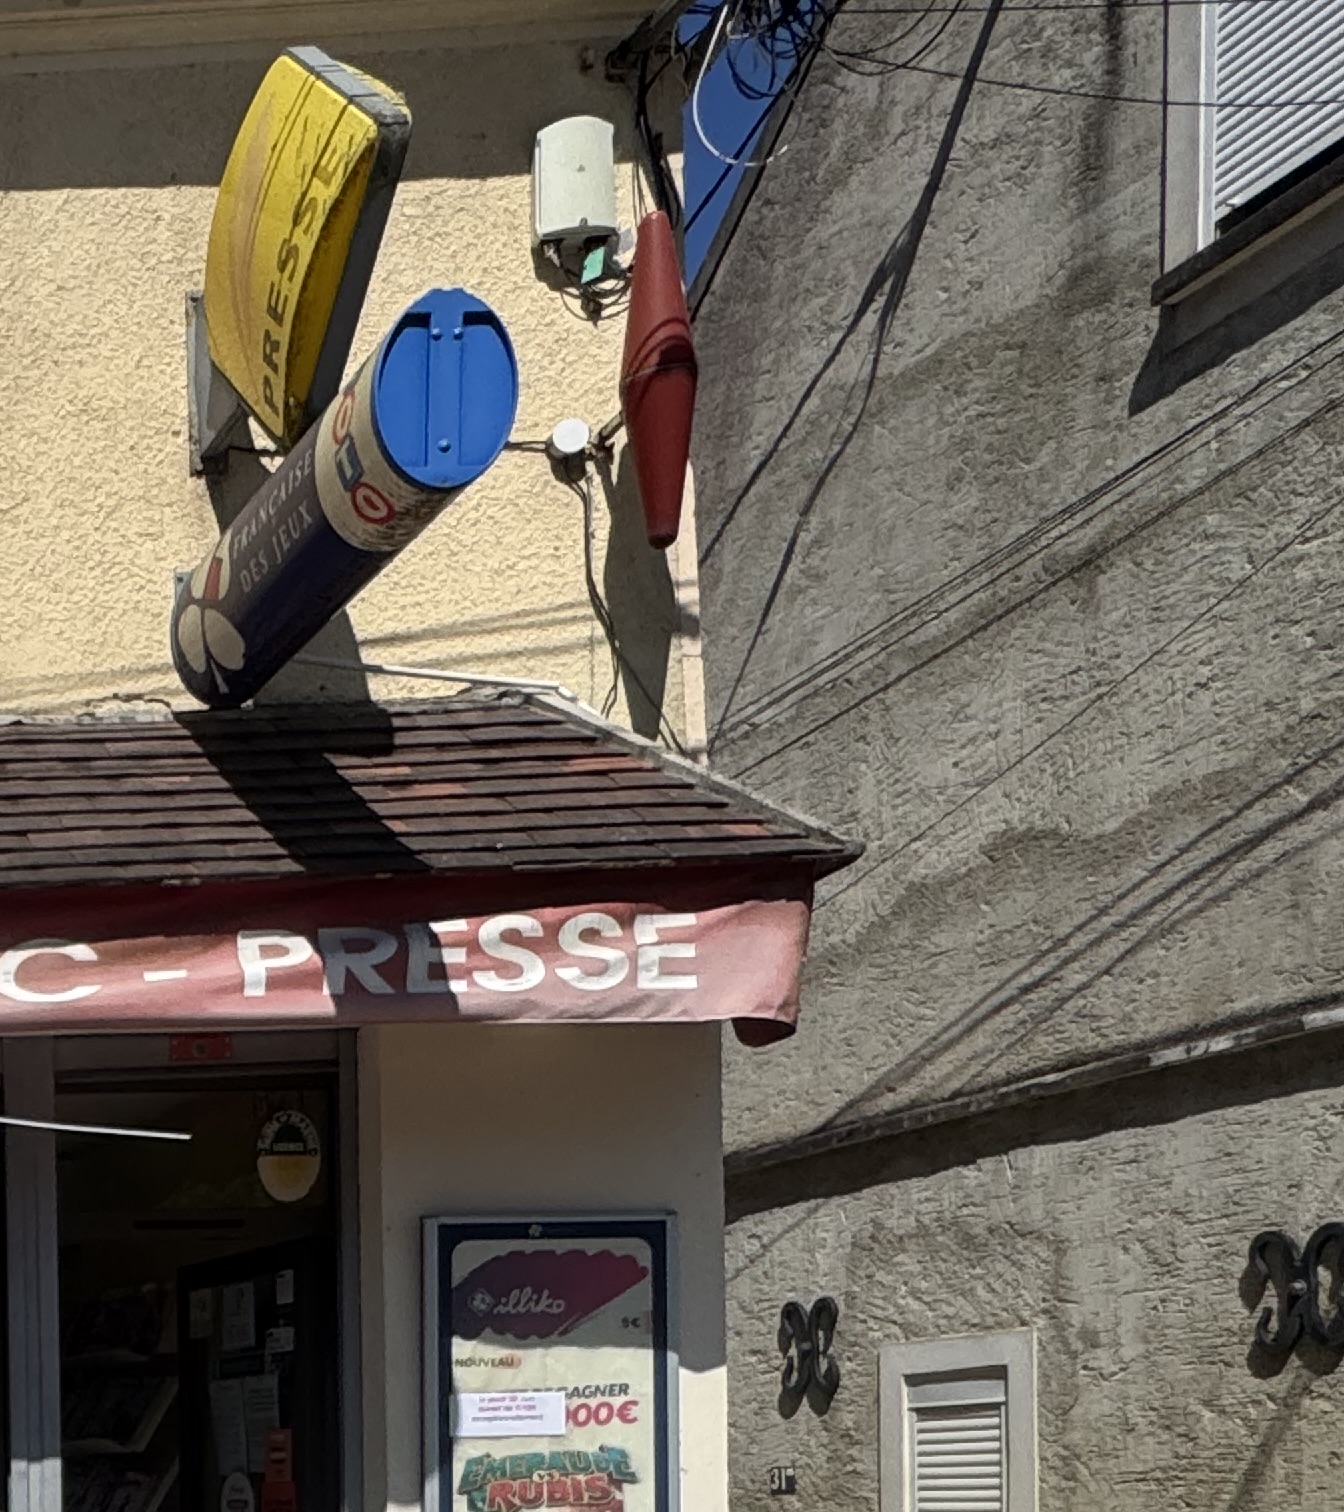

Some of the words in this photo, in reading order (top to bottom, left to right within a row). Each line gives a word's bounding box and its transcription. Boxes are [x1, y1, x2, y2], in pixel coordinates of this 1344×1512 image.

[262, 133, 354, 418] PRESSE
[231, 448, 314, 560] FRANÇAISE
[240, 555, 270, 593] DES
[273, 503, 314, 565] JEUX
[236, 911, 699, 998] PRESSE
[492, 1286, 566, 1315] illiko
[454, 1357, 516, 1369] NOUVEAU
